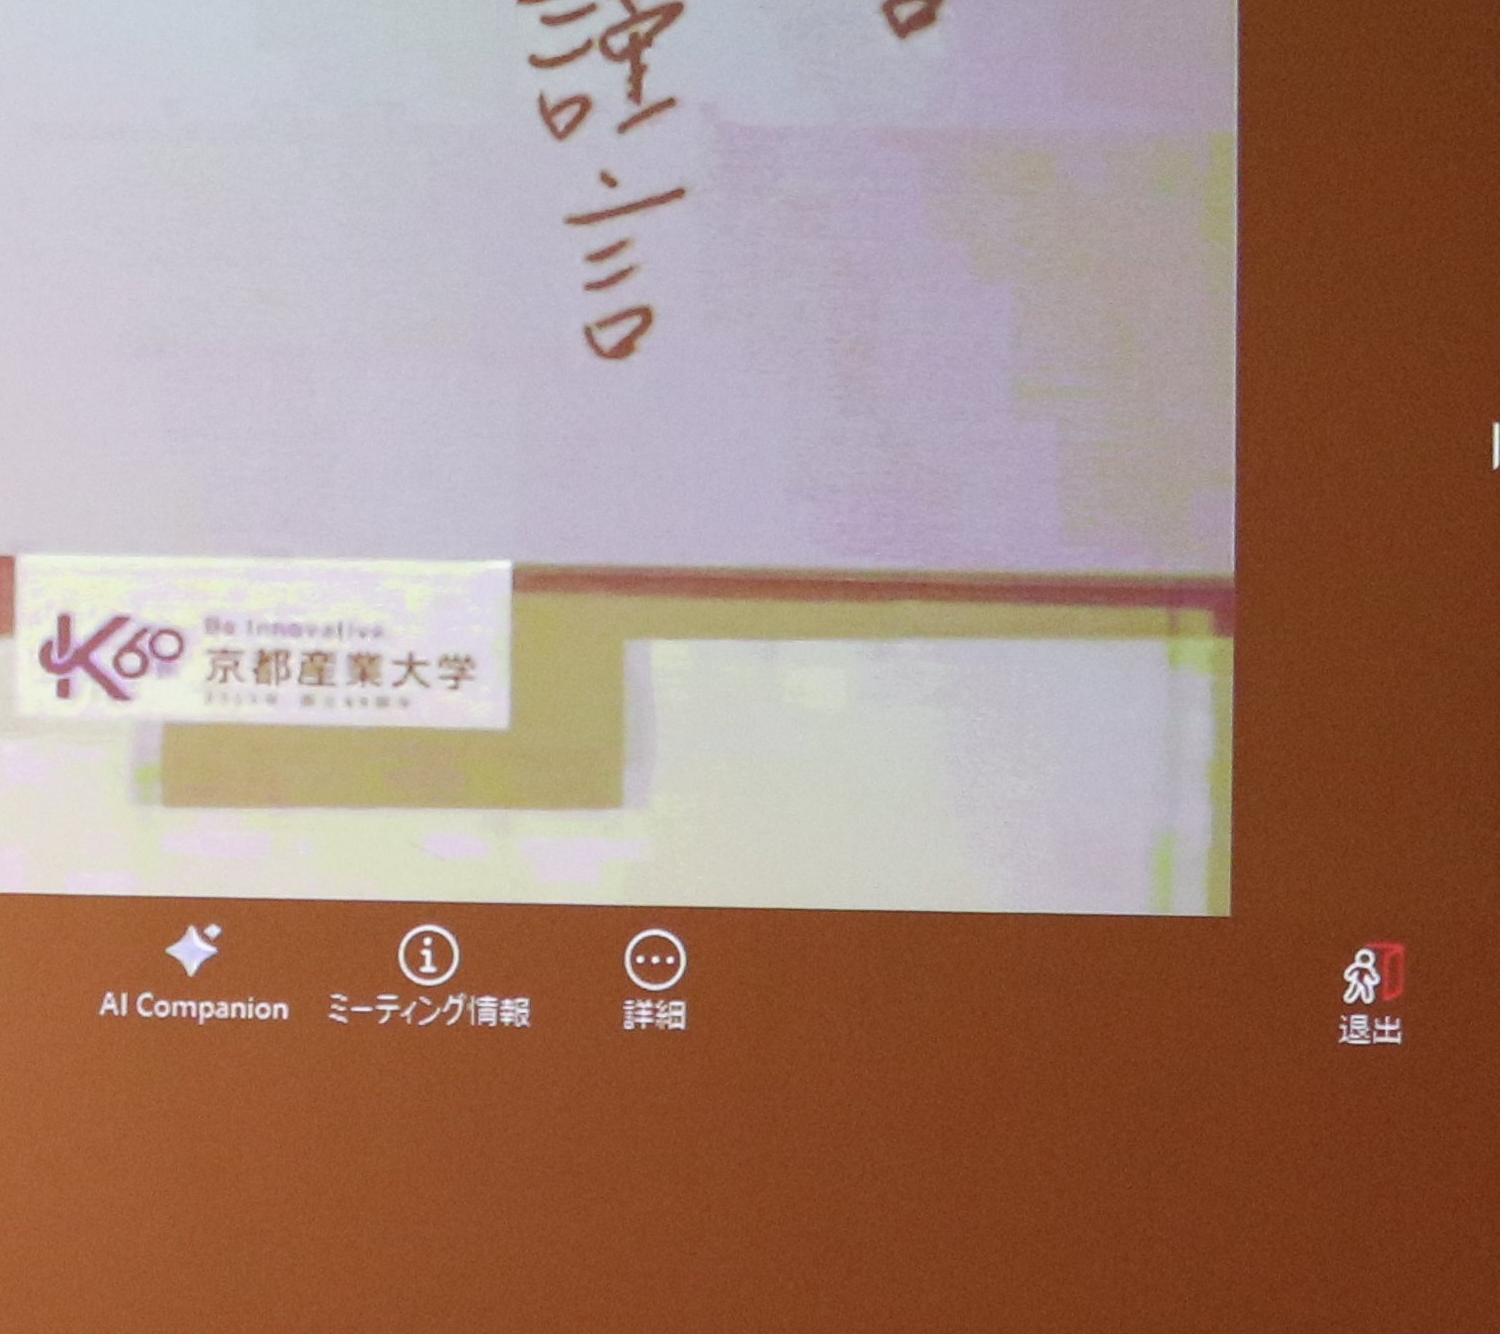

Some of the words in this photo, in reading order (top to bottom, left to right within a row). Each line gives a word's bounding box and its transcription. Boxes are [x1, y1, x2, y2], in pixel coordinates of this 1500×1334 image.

[206, 649, 477, 689] 京都産業大学
[100, 993, 129, 1017] AI
[136, 994, 288, 1022] Companion
[328, 992, 531, 1028] ミーティング情報
[623, 998, 686, 1031] 詳細
[1339, 1014, 1402, 1044] 退出
